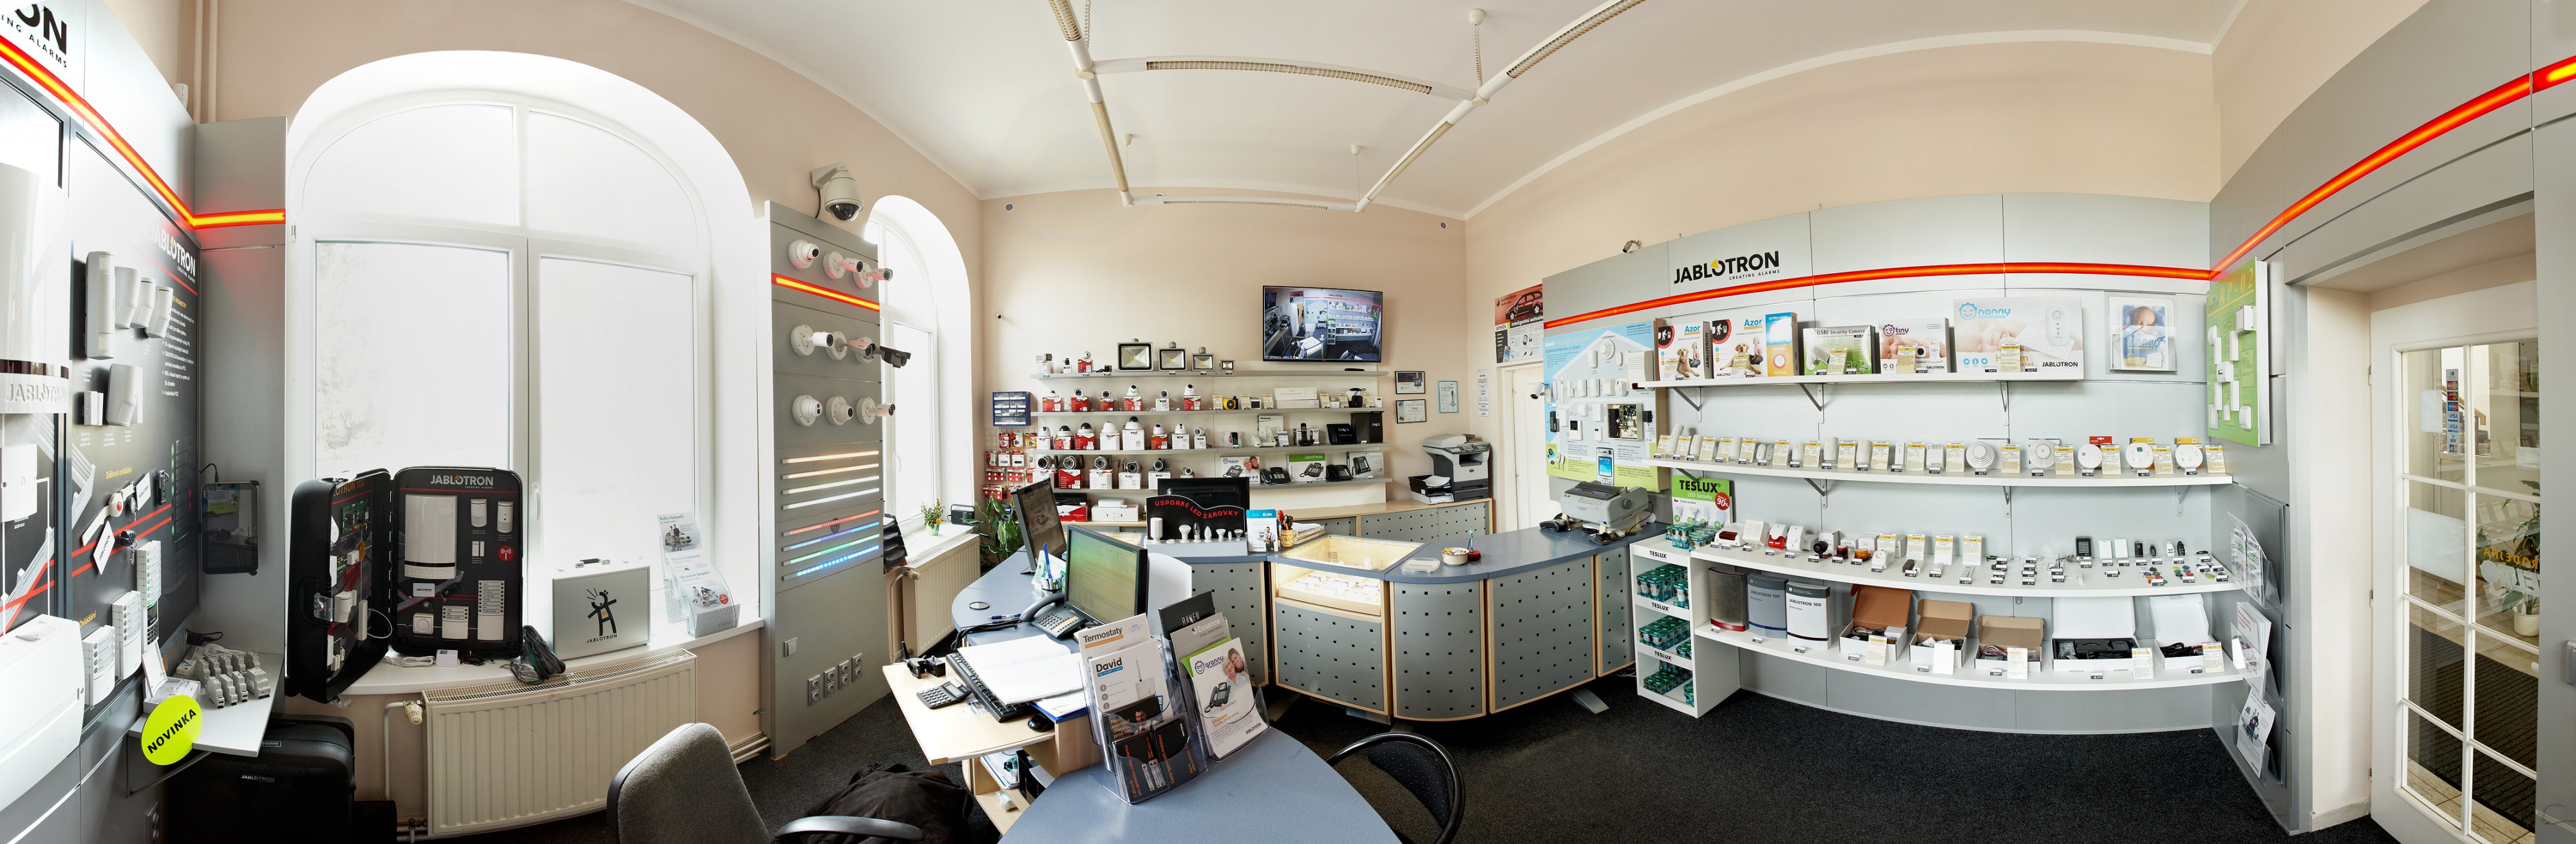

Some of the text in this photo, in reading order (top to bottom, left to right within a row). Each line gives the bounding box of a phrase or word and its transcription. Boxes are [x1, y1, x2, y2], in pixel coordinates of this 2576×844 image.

[29, 34, 67, 68] ALARMS
[149, 225, 196, 278] JABLOTRON
[1674, 250, 1780, 284] JABLOTRON
[1978, 308, 2011, 317] nanny
[2127, 337, 2162, 350] nanny
[7, 383, 68, 403] JABLOTRON
[430, 475, 494, 486] JABLOTRON
[1679, 479, 1719, 494] TESLUX
[1696, 492, 1713, 501] žárovky
[1189, 506, 1202, 517] LED
[1202, 509, 1239, 519] ŽÁROVKY
[1649, 550, 1667, 559] TESLUX
[408, 568, 450, 577] JABLOTRON
[1750, 590, 1772, 598] JABLOTRON
[1651, 602, 1669, 611] TESLUX
[1789, 598, 1812, 606] JABLOTRON
[79, 610, 96, 629] Ovládání
[1182, 611, 1200, 626] RAVEN
[1197, 619, 1221, 633] Essence
[586, 633, 618, 644] JABLOTRON
[1083, 627, 1123, 643] Termostaty
[1205, 655, 1224, 669] granny
[1654, 651, 1672, 660] TESLUX
[1095, 657, 1122, 673] David
[1112, 718, 1130, 729] existovat
[1211, 713, 1228, 726] Stiskem
[147, 709, 197, 755] NOVINKA
[1245, 722, 1262, 735] JABLOTRON
[1187, 751, 1197, 772] JABLOTRON
